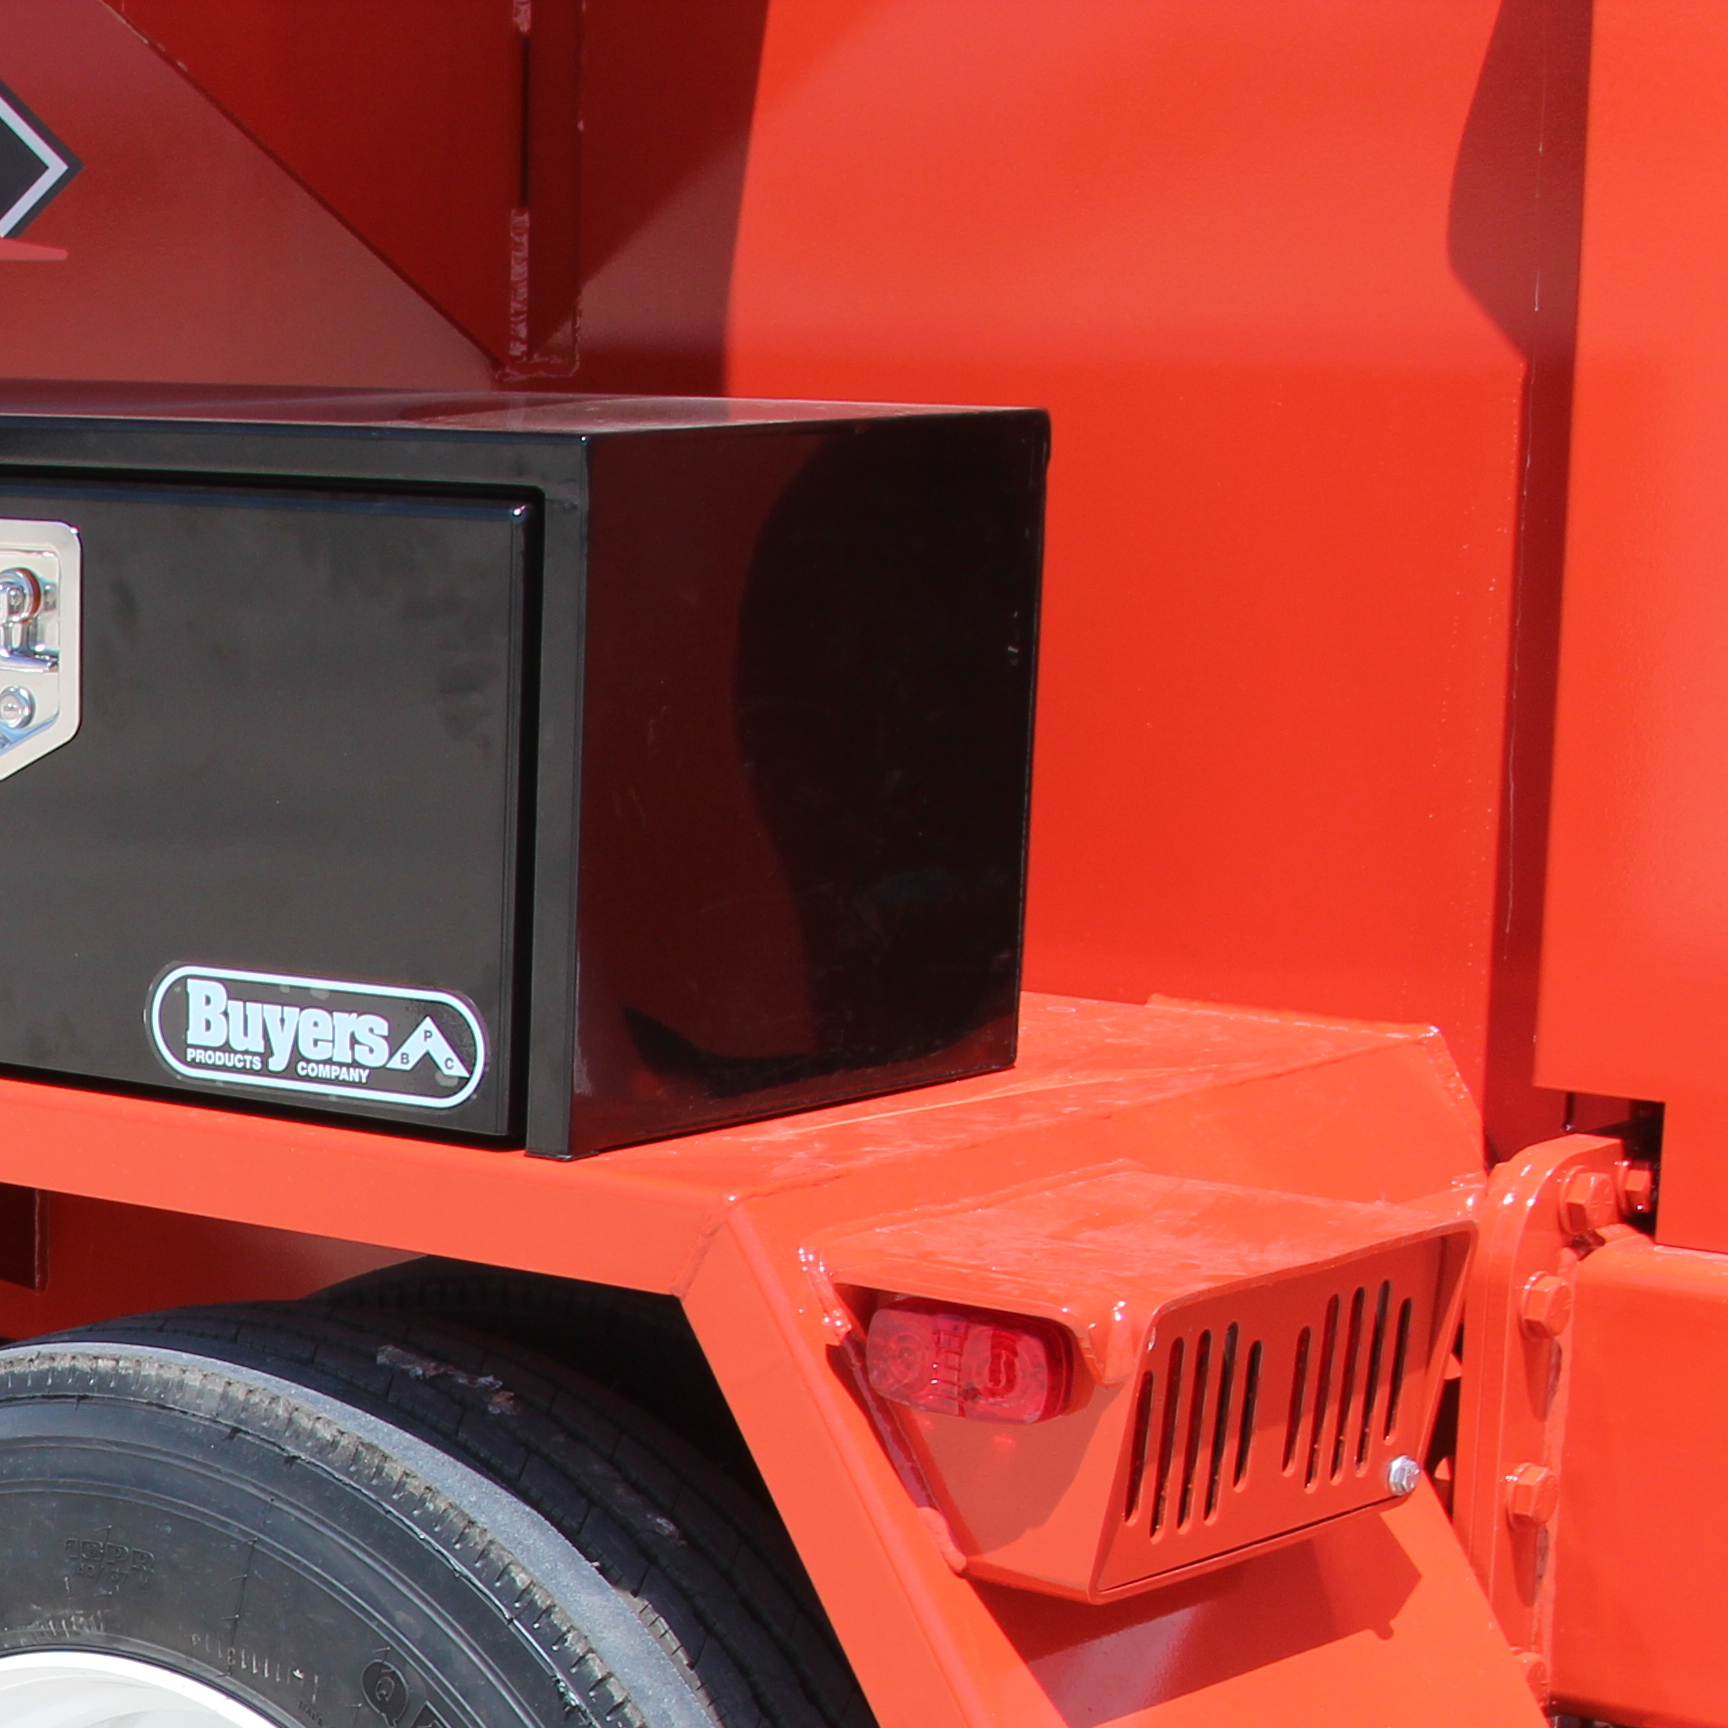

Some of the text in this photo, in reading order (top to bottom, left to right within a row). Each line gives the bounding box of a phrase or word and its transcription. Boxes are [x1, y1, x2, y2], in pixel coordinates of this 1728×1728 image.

[185, 977, 391, 1073] Buyers
[186, 1047, 371, 1084] PRODUCTS COMPANY
